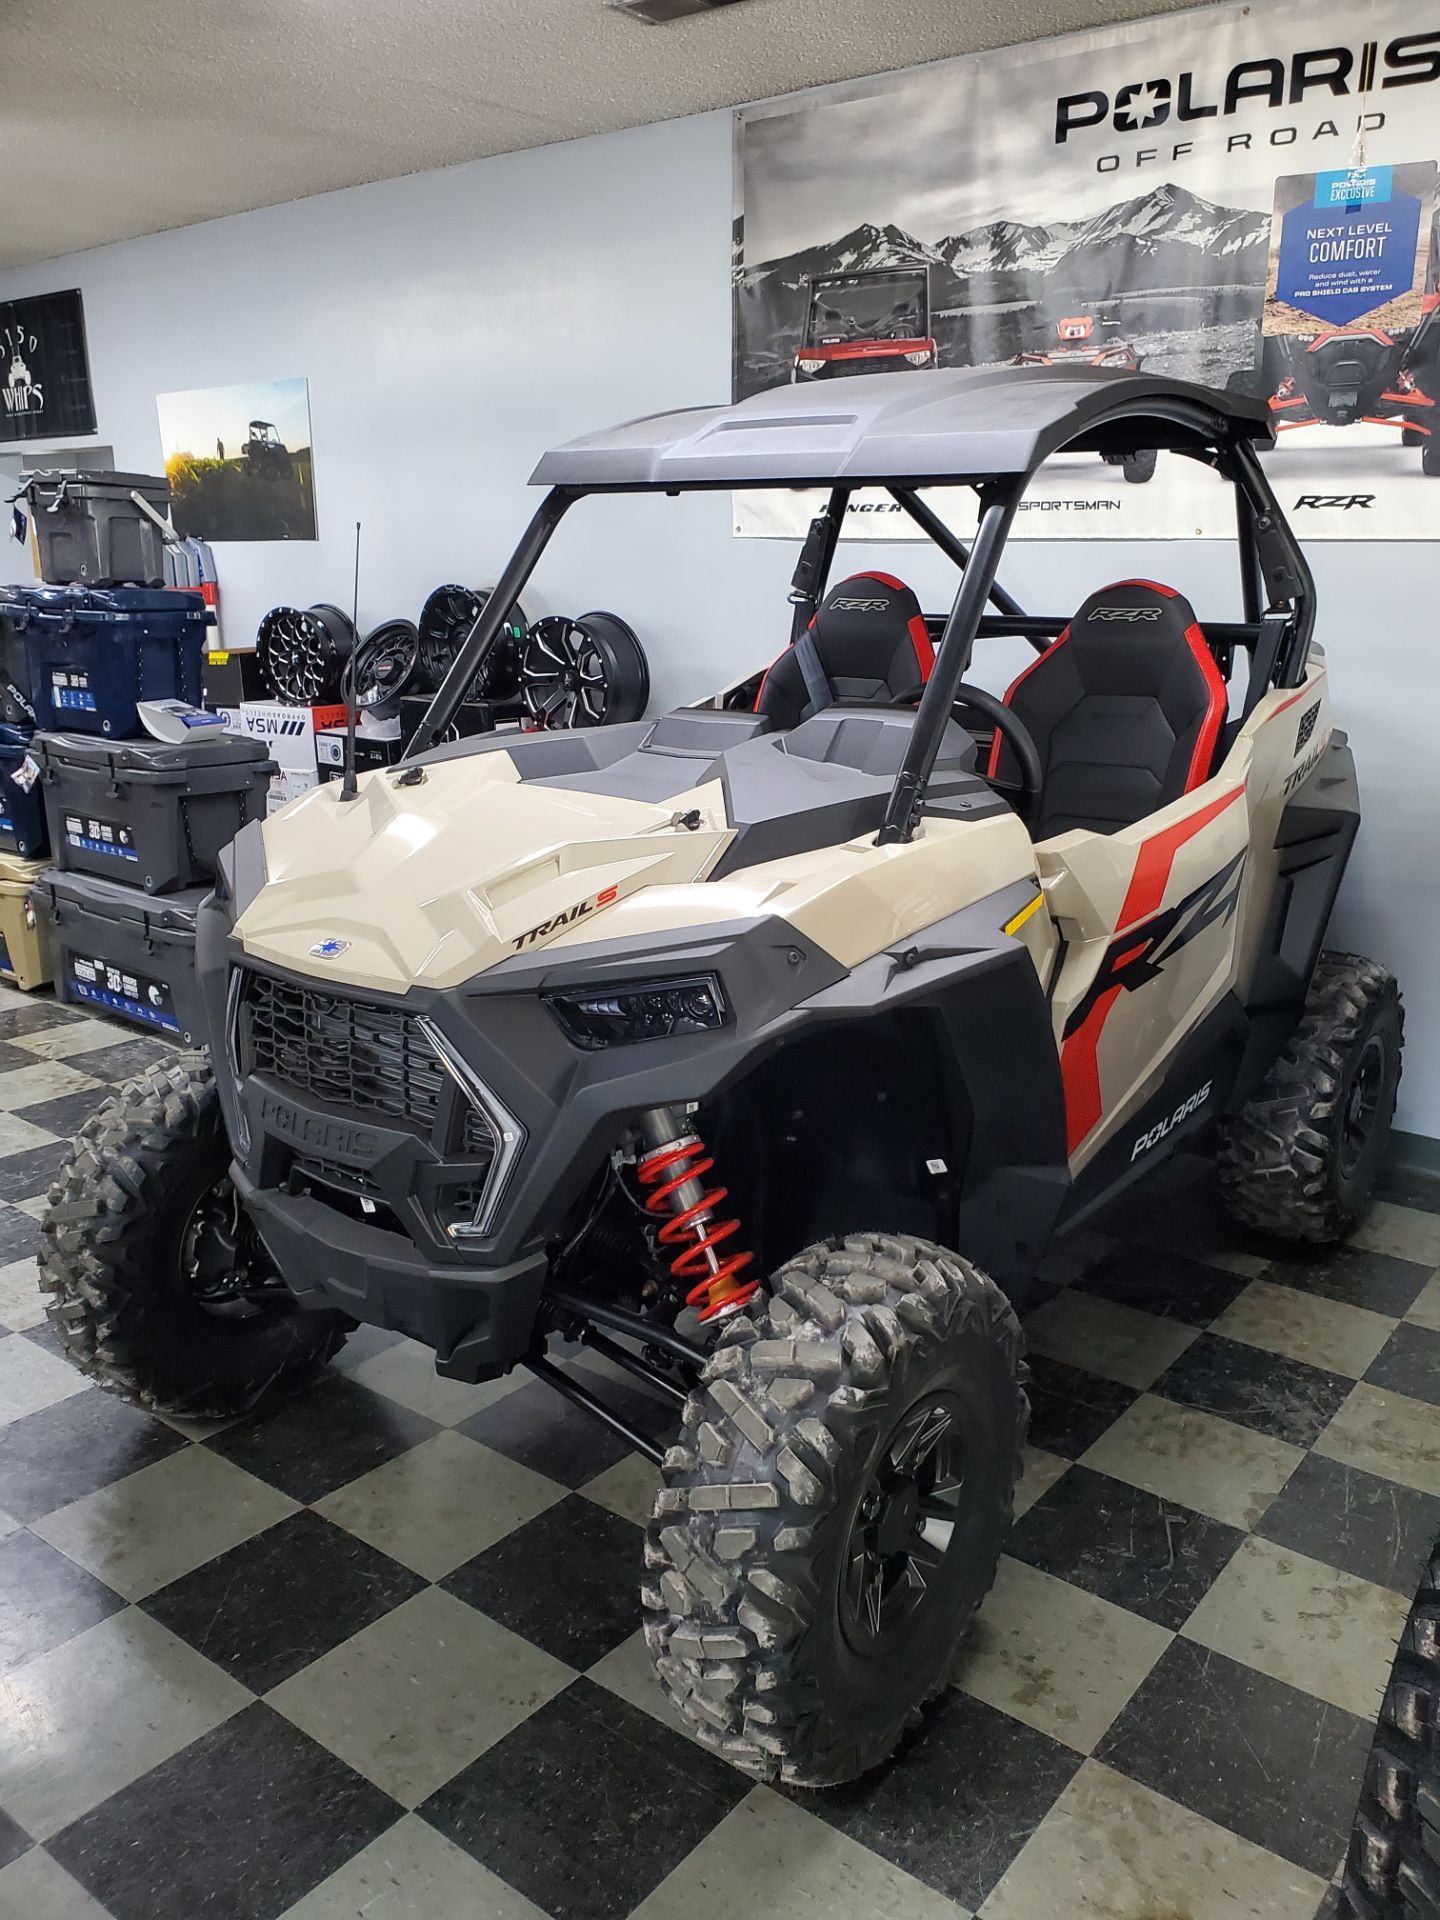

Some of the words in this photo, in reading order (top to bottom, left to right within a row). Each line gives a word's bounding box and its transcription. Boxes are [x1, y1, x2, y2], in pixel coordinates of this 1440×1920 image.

[1055, 31, 1440, 144] POLARIS
[1096, 142, 1194, 173] OFF
[1226, 112, 1386, 153] ROAD
[1330, 186, 1376, 202] EXCLUSIVE
[1306, 226, 1344, 240] NEXT
[1348, 222, 1392, 236] LEVEL
[1309, 236, 1386, 263] COMFORT
[1308, 272, 1337, 281] Reduce
[1338, 270, 1357, 279] dust,
[1315, 280, 1330, 288] and
[1331, 279, 1348, 287] wind
[1350, 277, 1366, 285] with
[1294, 290, 1311, 298] PRO
[1312, 288, 1341, 296] SHIELD
[1342, 286, 1359, 294] CAB
[1360, 283, 1393, 293] SYSTEM
[2, 383, 44, 412] WHIPS
[819, 503, 902, 513] RNGER
[1018, 500, 1121, 511] SPORTSMAN
[1292, 494, 1377, 511] RZR
[829, 597, 890, 611] RZR
[1087, 607, 1163, 621] RZR
[246, 716, 278, 735] MSA
[512, 901, 593, 951] TRAIL
[596, 884, 618, 909] S
[261, 1098, 379, 1156] POLARIS
[1130, 1079, 1213, 1162] POLARIS
